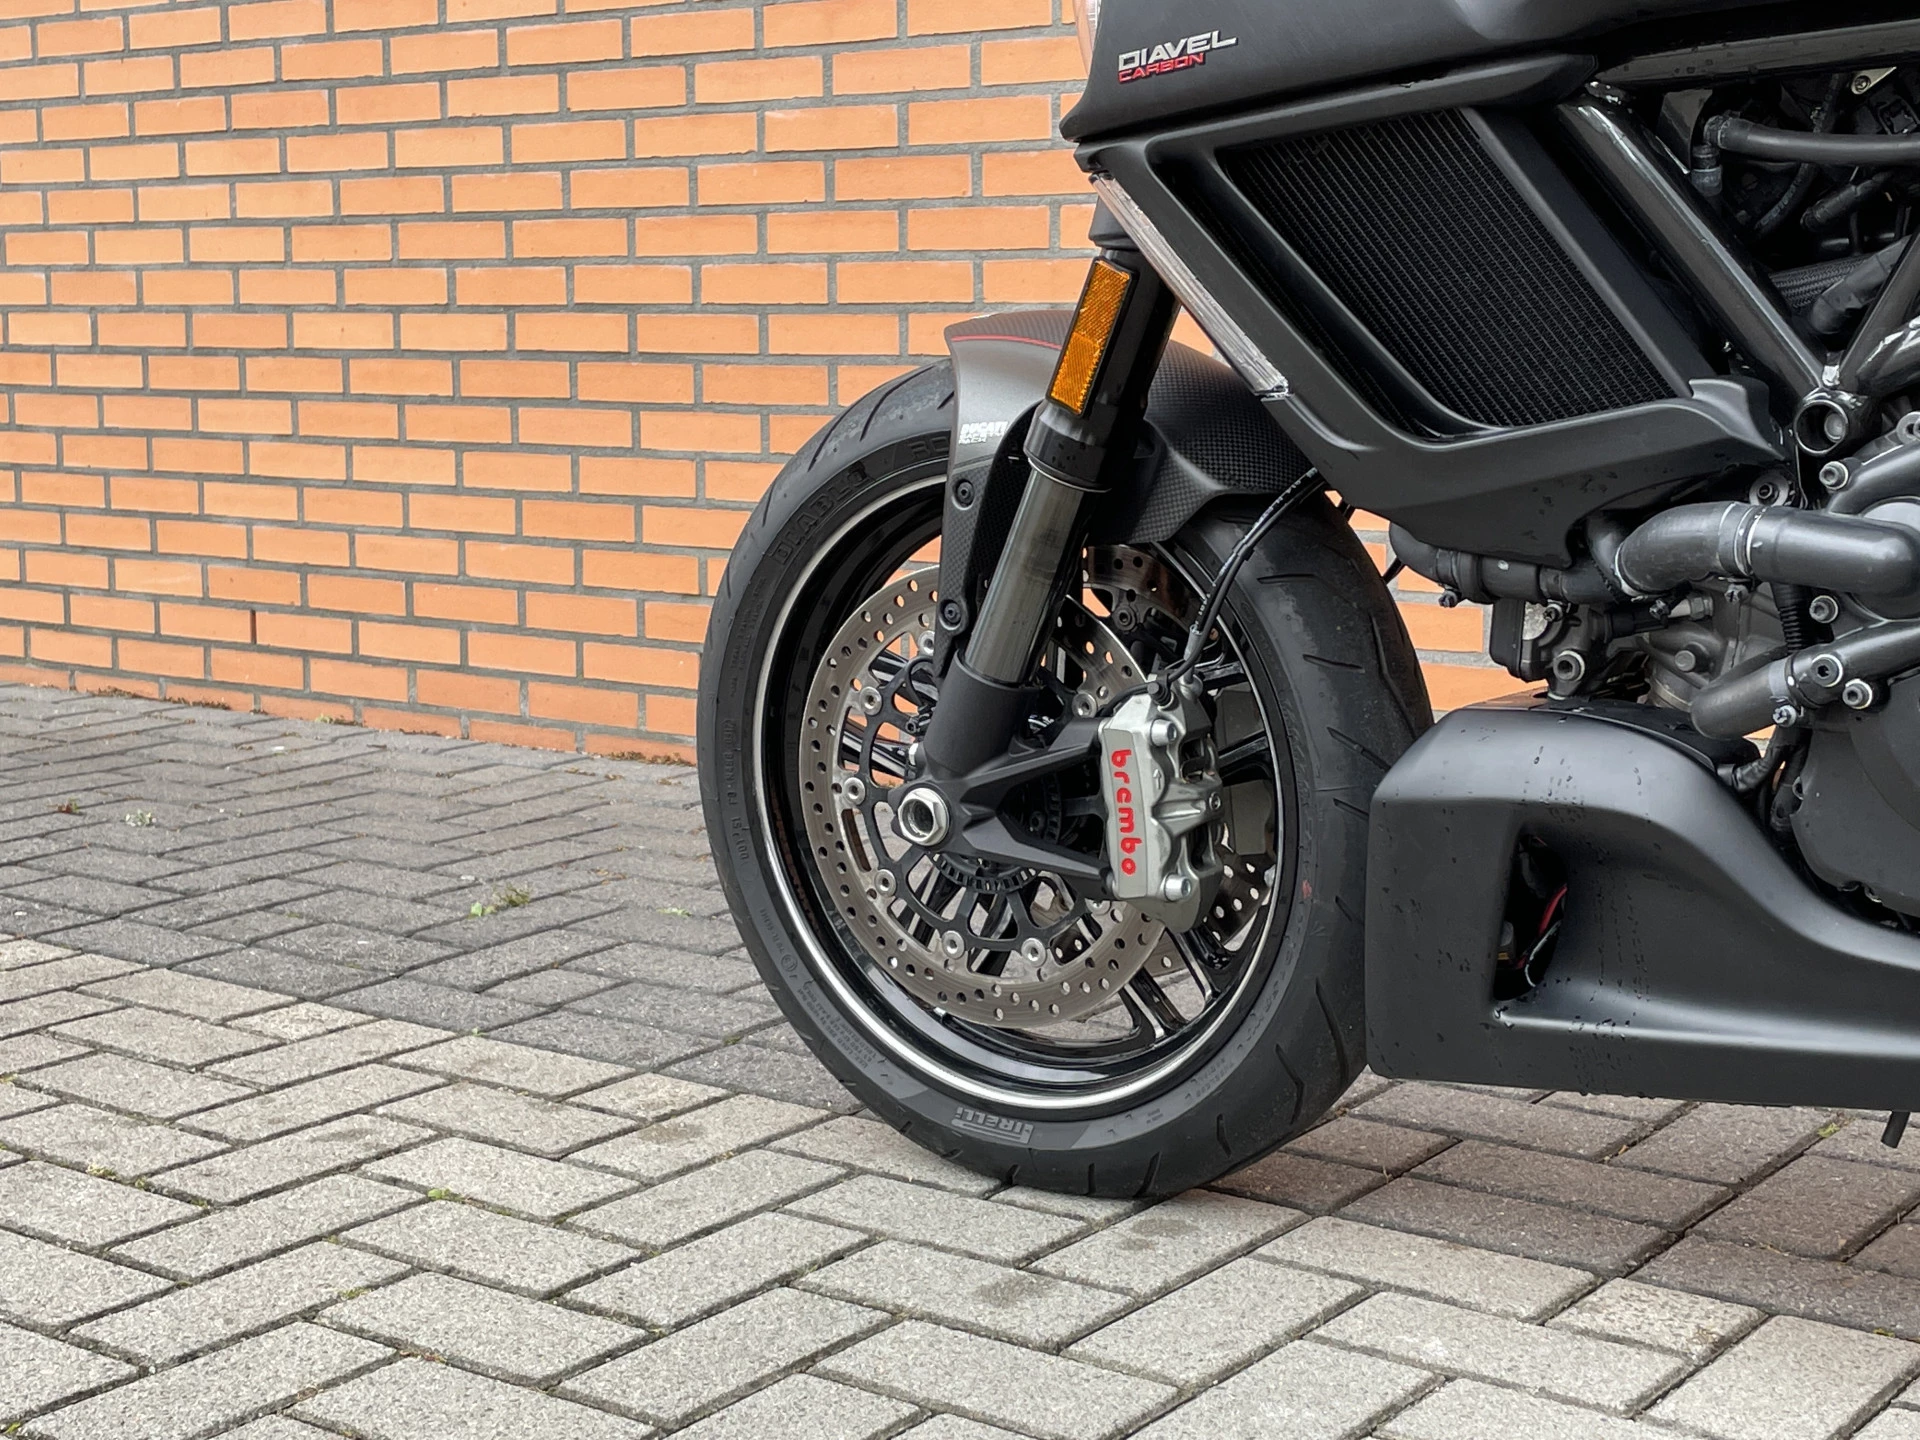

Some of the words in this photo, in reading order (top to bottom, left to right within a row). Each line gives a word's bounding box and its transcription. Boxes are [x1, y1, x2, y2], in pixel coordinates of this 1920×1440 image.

[1118, 30, 1238, 71] DIAVEL
[1118, 52, 1205, 83] CARBON
[768, 460, 869, 565] DIABLO
[1111, 749, 1142, 876] brembo
[951, 1107, 1034, 1144] PIRELLI
